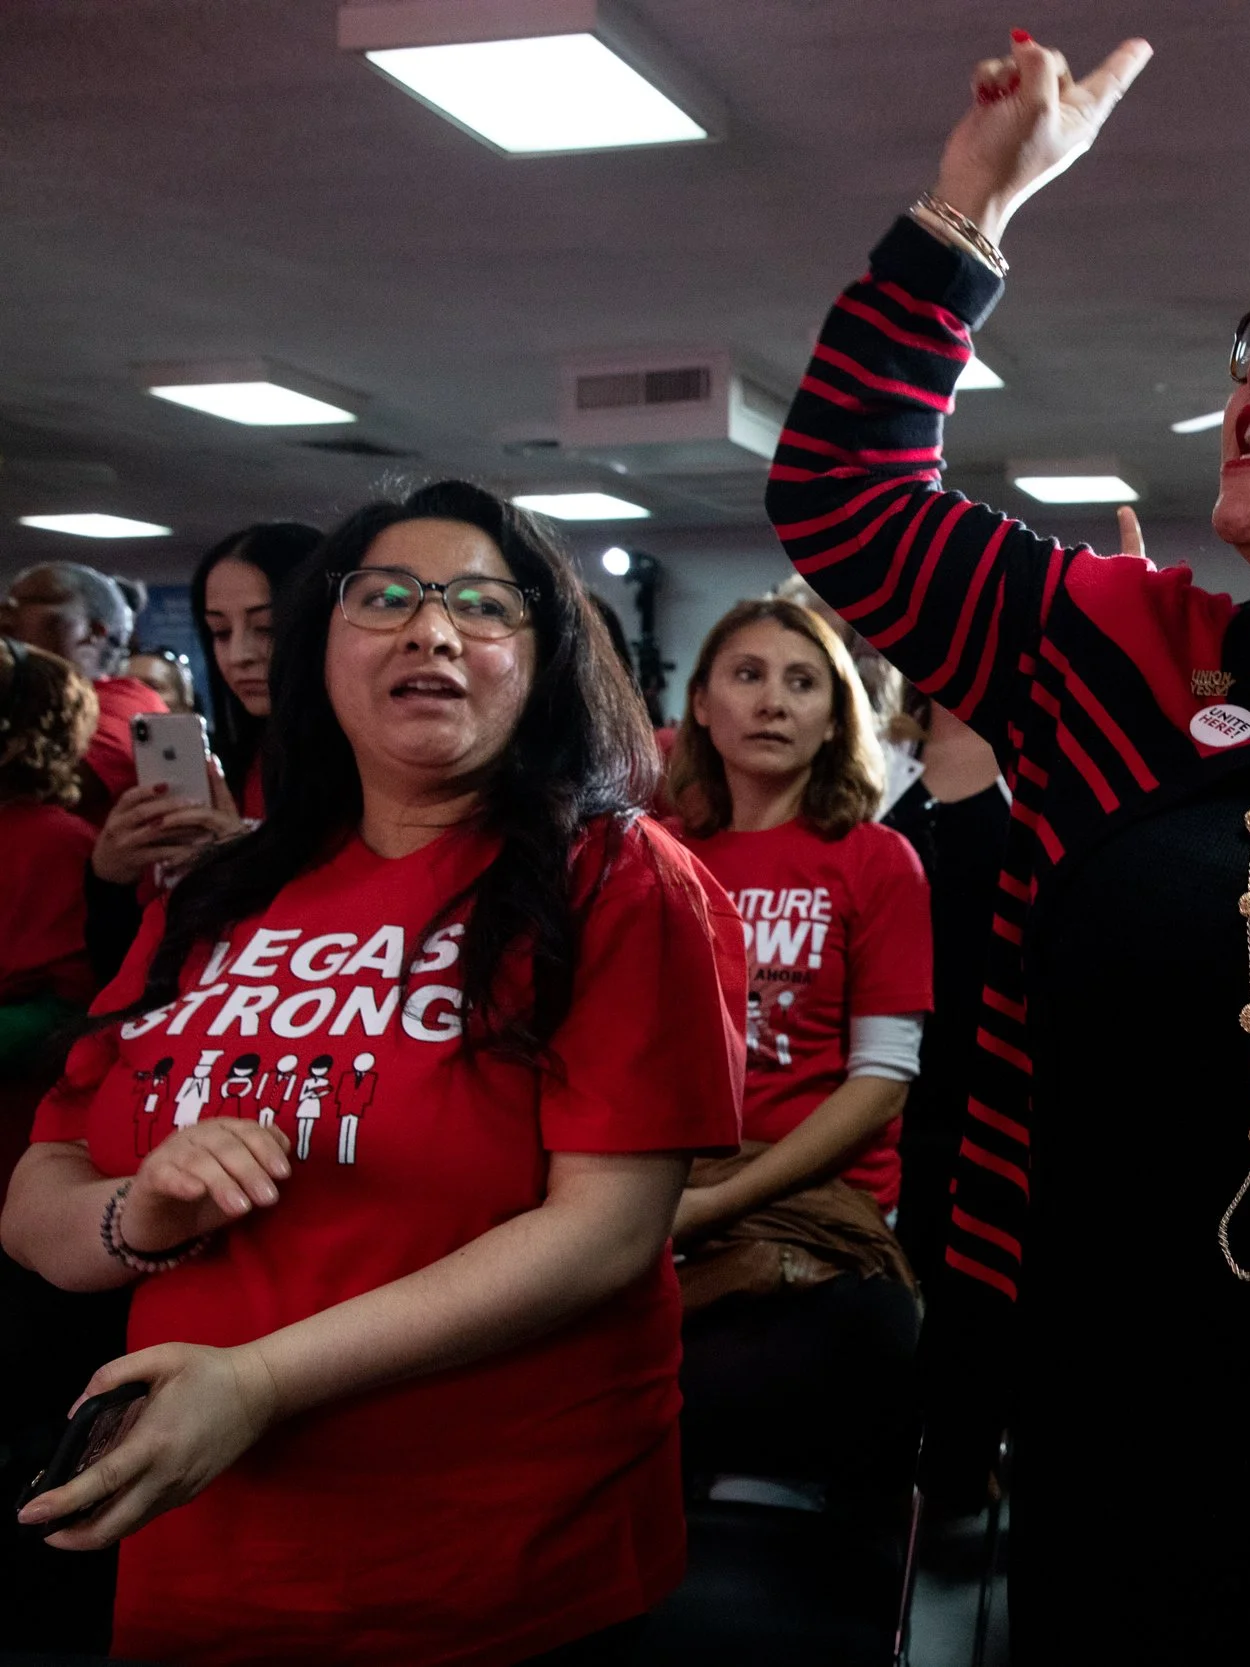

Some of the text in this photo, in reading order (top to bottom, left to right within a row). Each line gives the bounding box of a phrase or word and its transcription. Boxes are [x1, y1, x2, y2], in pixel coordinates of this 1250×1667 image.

[1191, 668, 1233, 686] UNION
[1198, 714, 1241, 739] HERE!
[728, 886, 832, 923] UTURE
[199, 923, 466, 983] VEGAS
[120, 982, 464, 1042] STRONG
